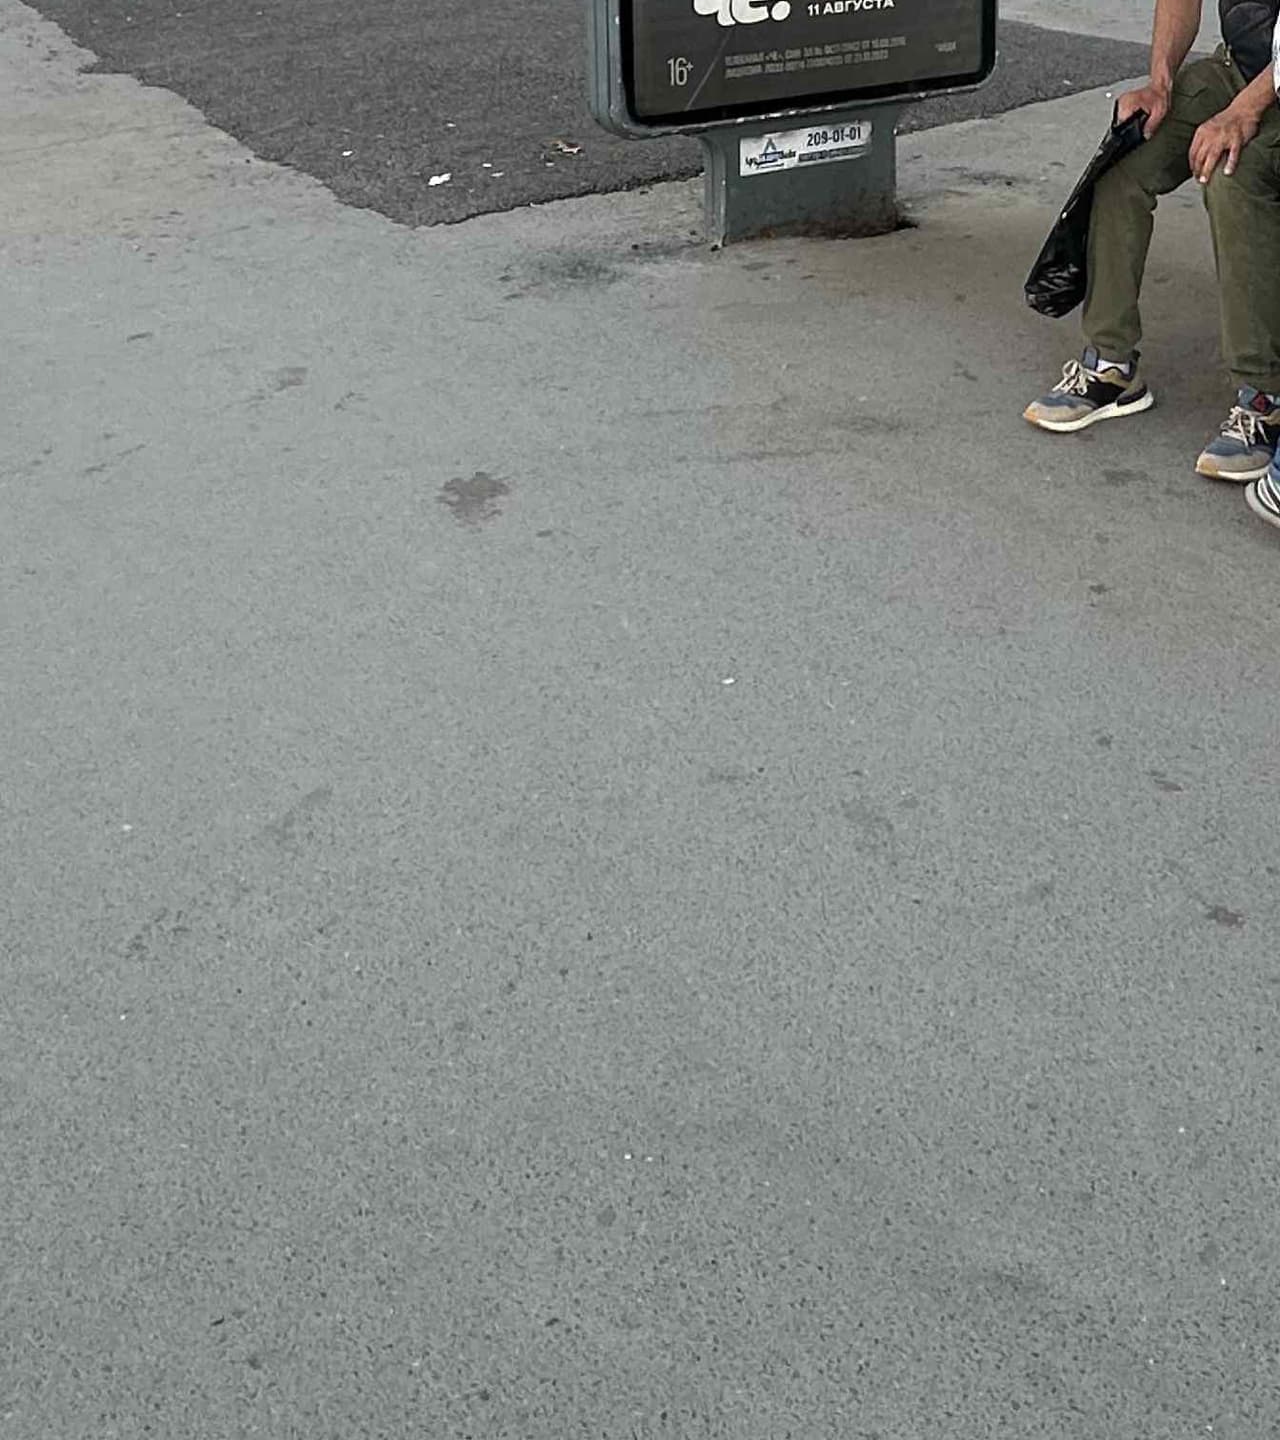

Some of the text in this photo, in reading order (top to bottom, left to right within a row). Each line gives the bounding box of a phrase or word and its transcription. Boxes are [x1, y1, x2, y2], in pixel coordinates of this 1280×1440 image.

[807, 3, 820, 16] 11
[667, 57, 694, 86] 16+
[807, 126, 861, 147] 209-01-01
